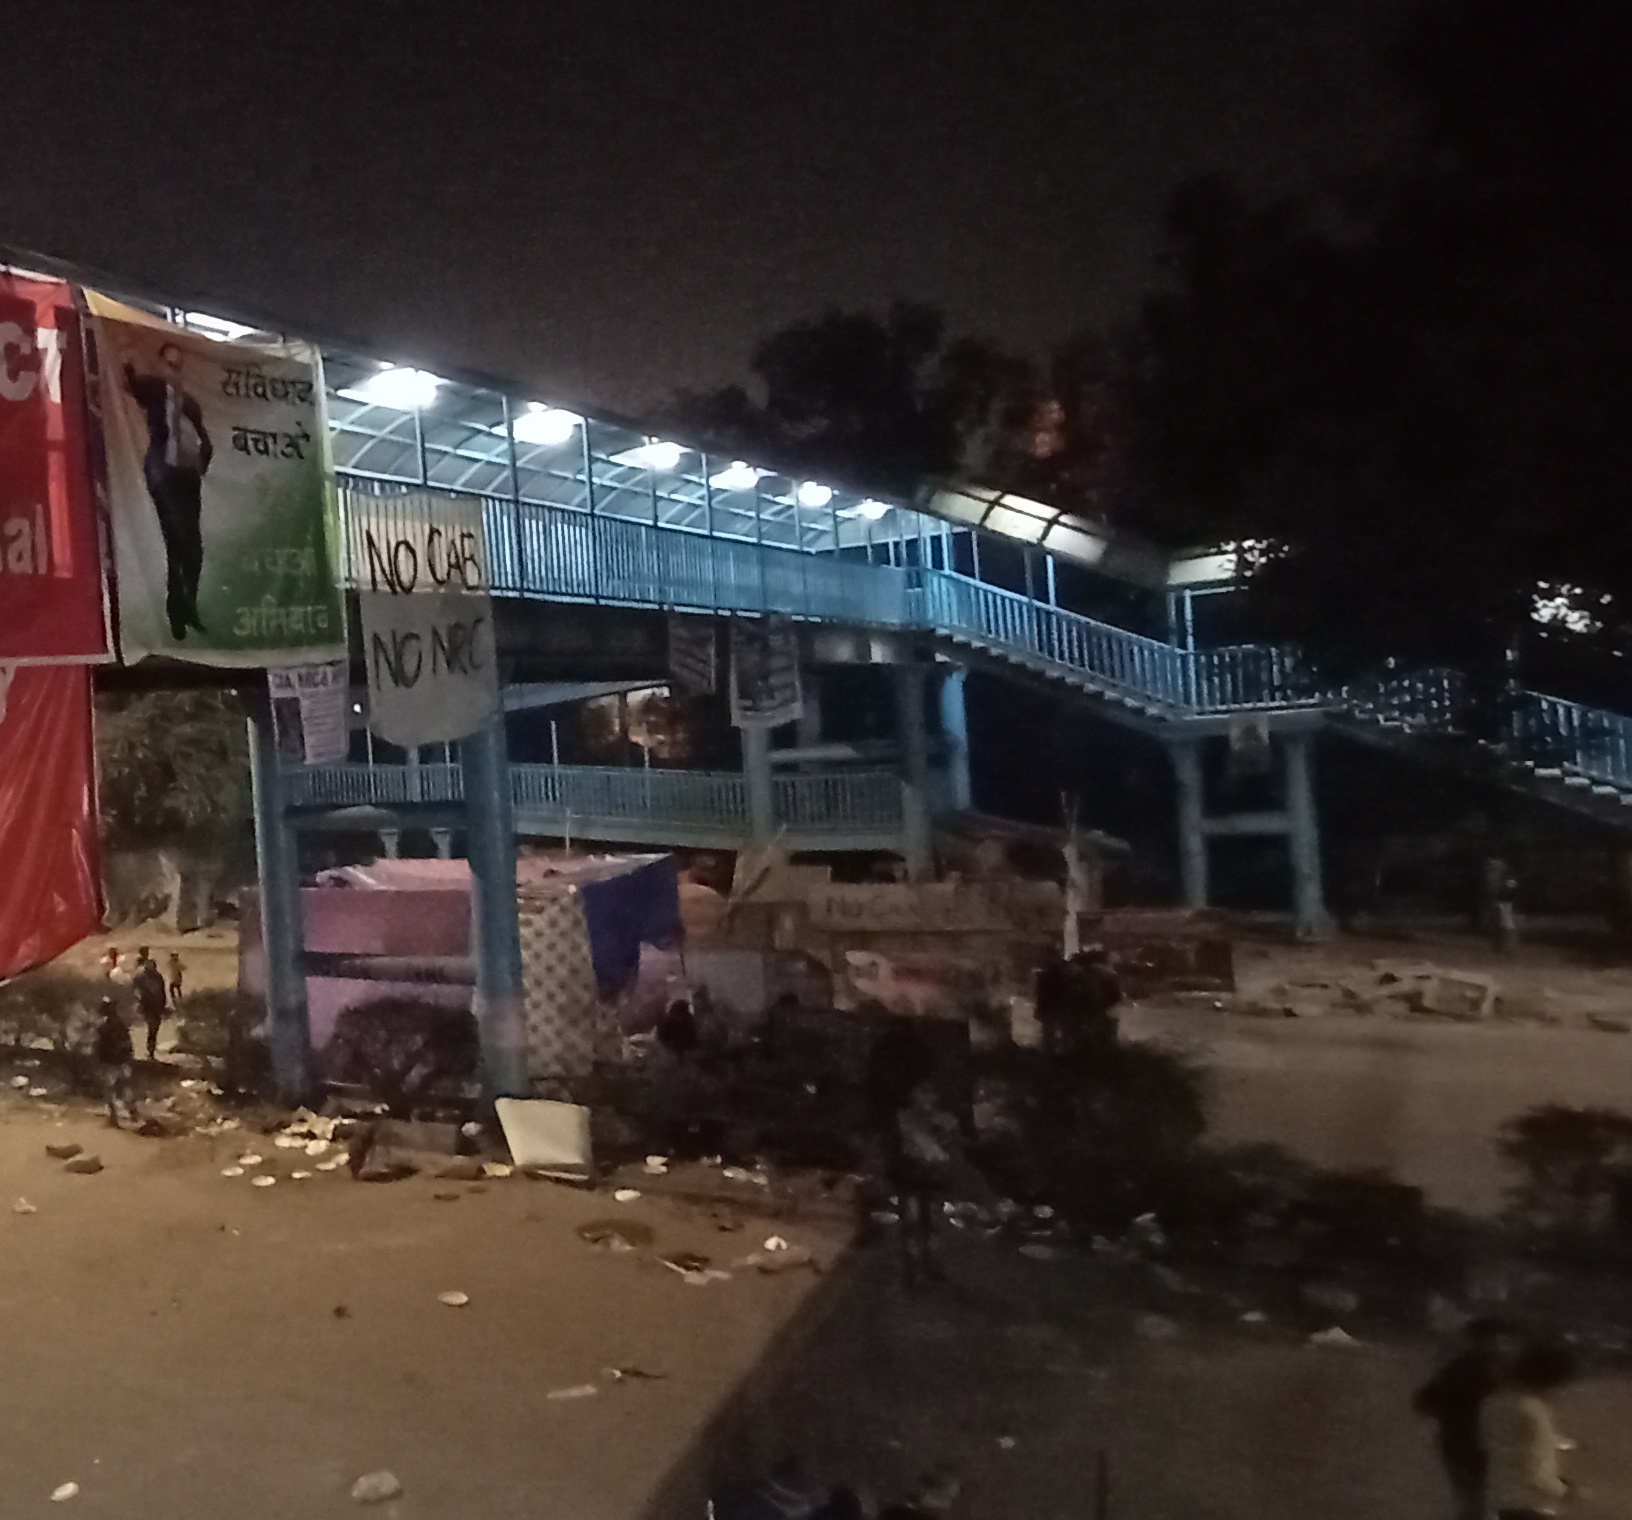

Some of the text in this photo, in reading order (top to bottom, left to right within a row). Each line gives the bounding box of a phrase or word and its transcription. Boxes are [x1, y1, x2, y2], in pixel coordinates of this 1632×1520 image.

[367, 524, 481, 596] NO CAB
[371, 629, 423, 692] NO
[430, 616, 485, 677] NRC
